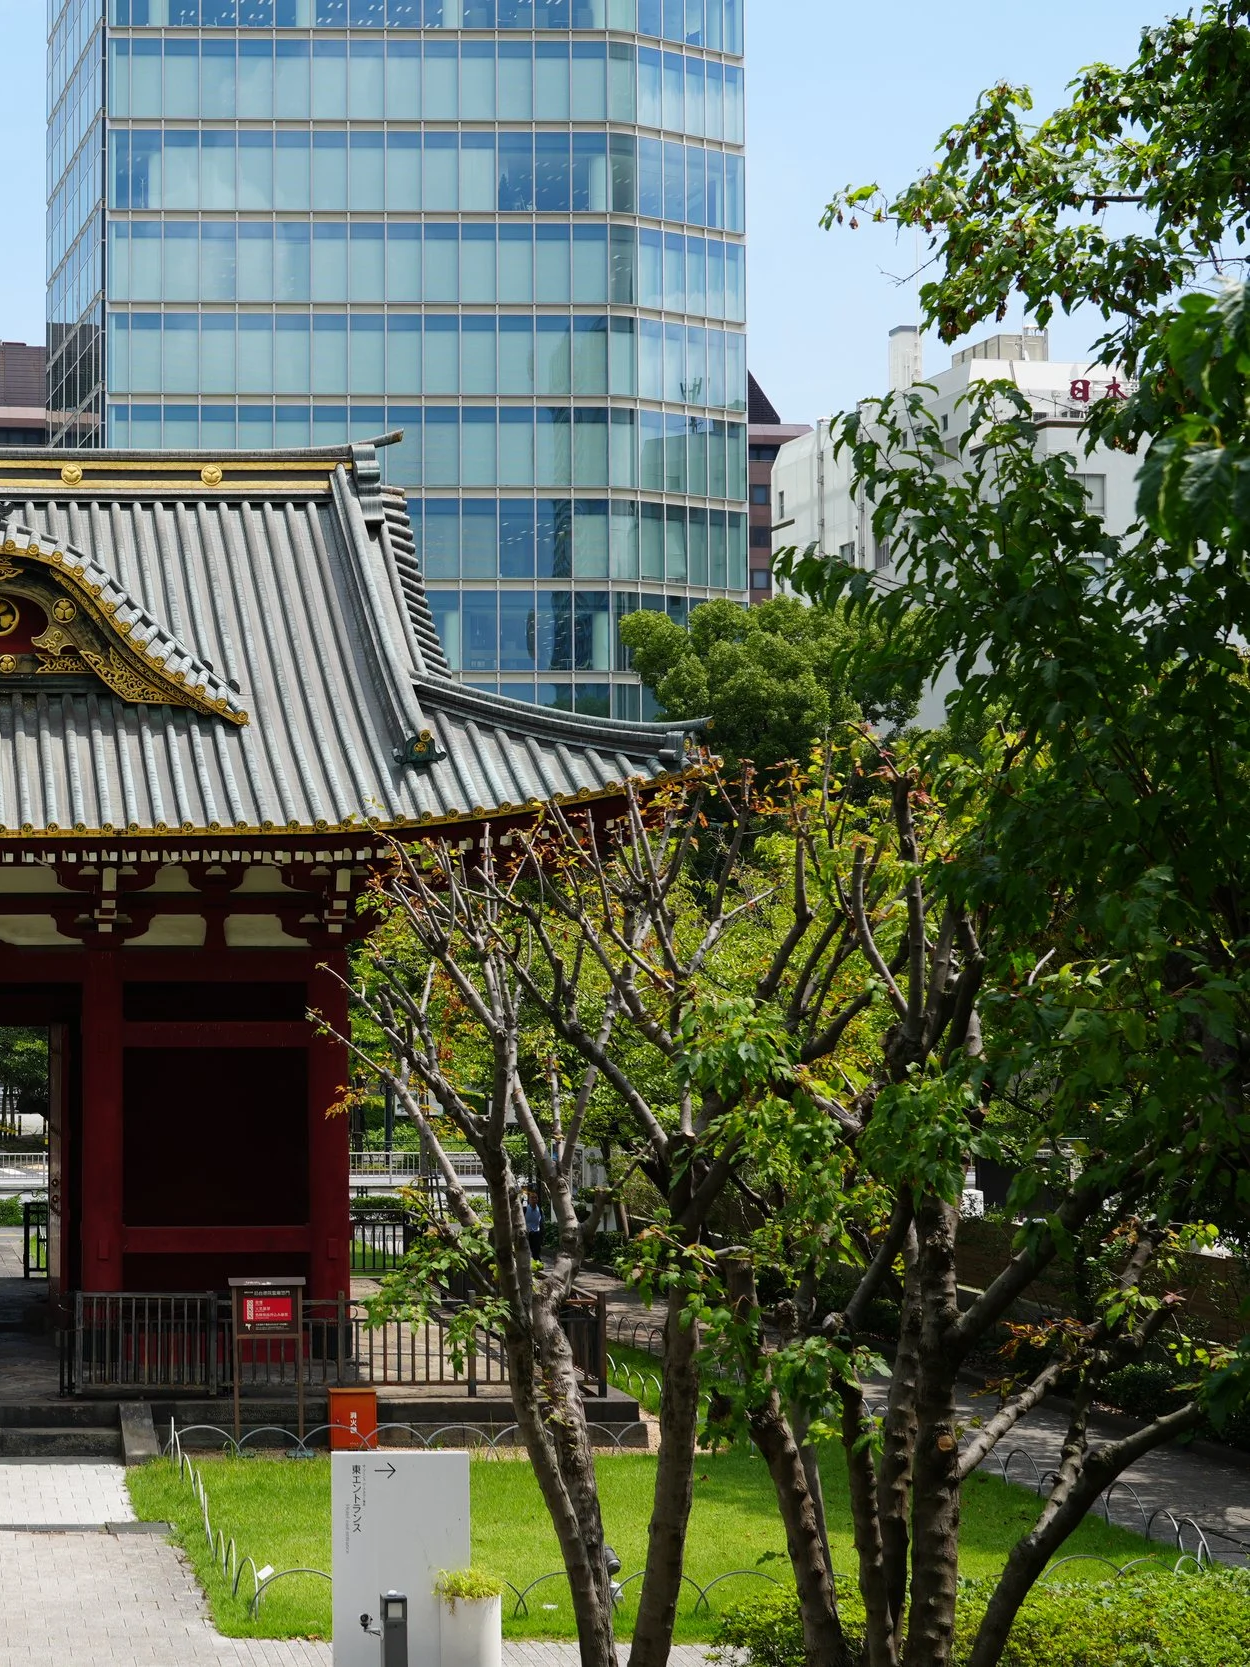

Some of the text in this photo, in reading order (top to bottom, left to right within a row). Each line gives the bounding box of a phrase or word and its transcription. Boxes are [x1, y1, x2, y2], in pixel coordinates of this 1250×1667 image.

[352, 1464, 362, 1533] 東エントランス
